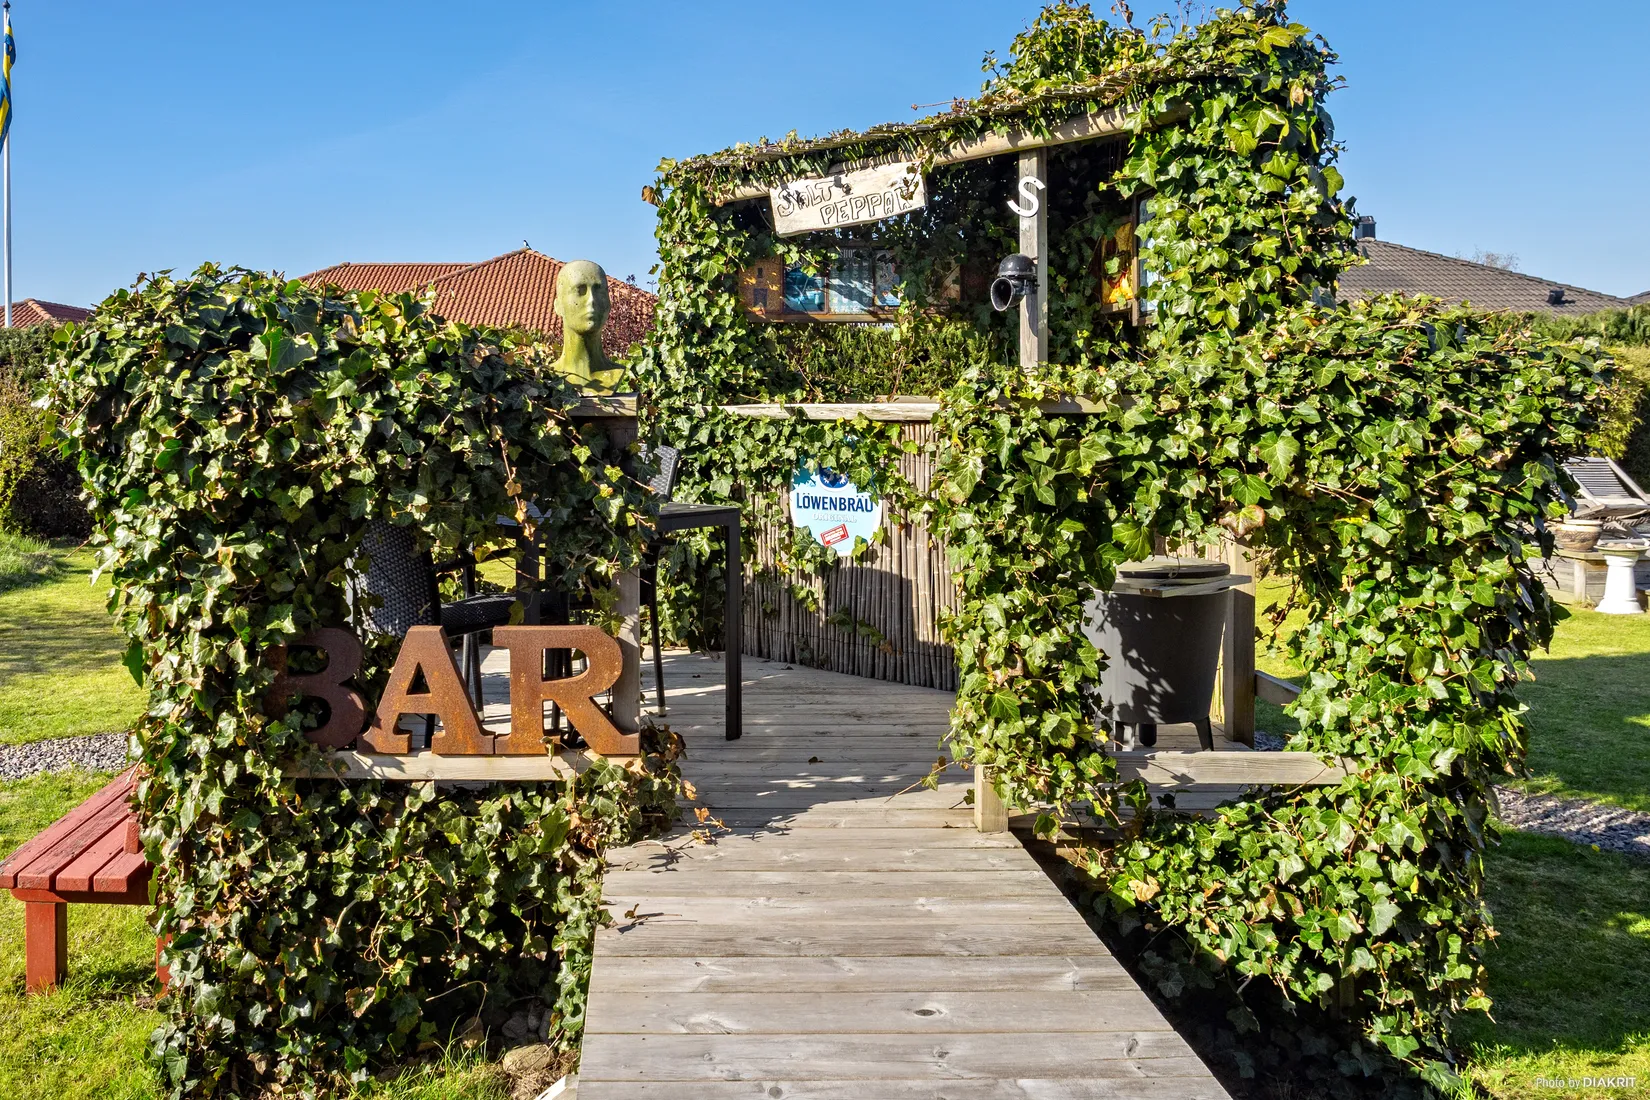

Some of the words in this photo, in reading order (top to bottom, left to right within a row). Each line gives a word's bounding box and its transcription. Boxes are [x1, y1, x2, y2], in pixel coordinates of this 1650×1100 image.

[776, 180, 836, 218] SALT
[1006, 175, 1046, 218] S
[796, 492, 874, 513] LÖWENBRÄU
[812, 513, 857, 523] ORIGINAL
[264, 625, 640, 756] BAR
